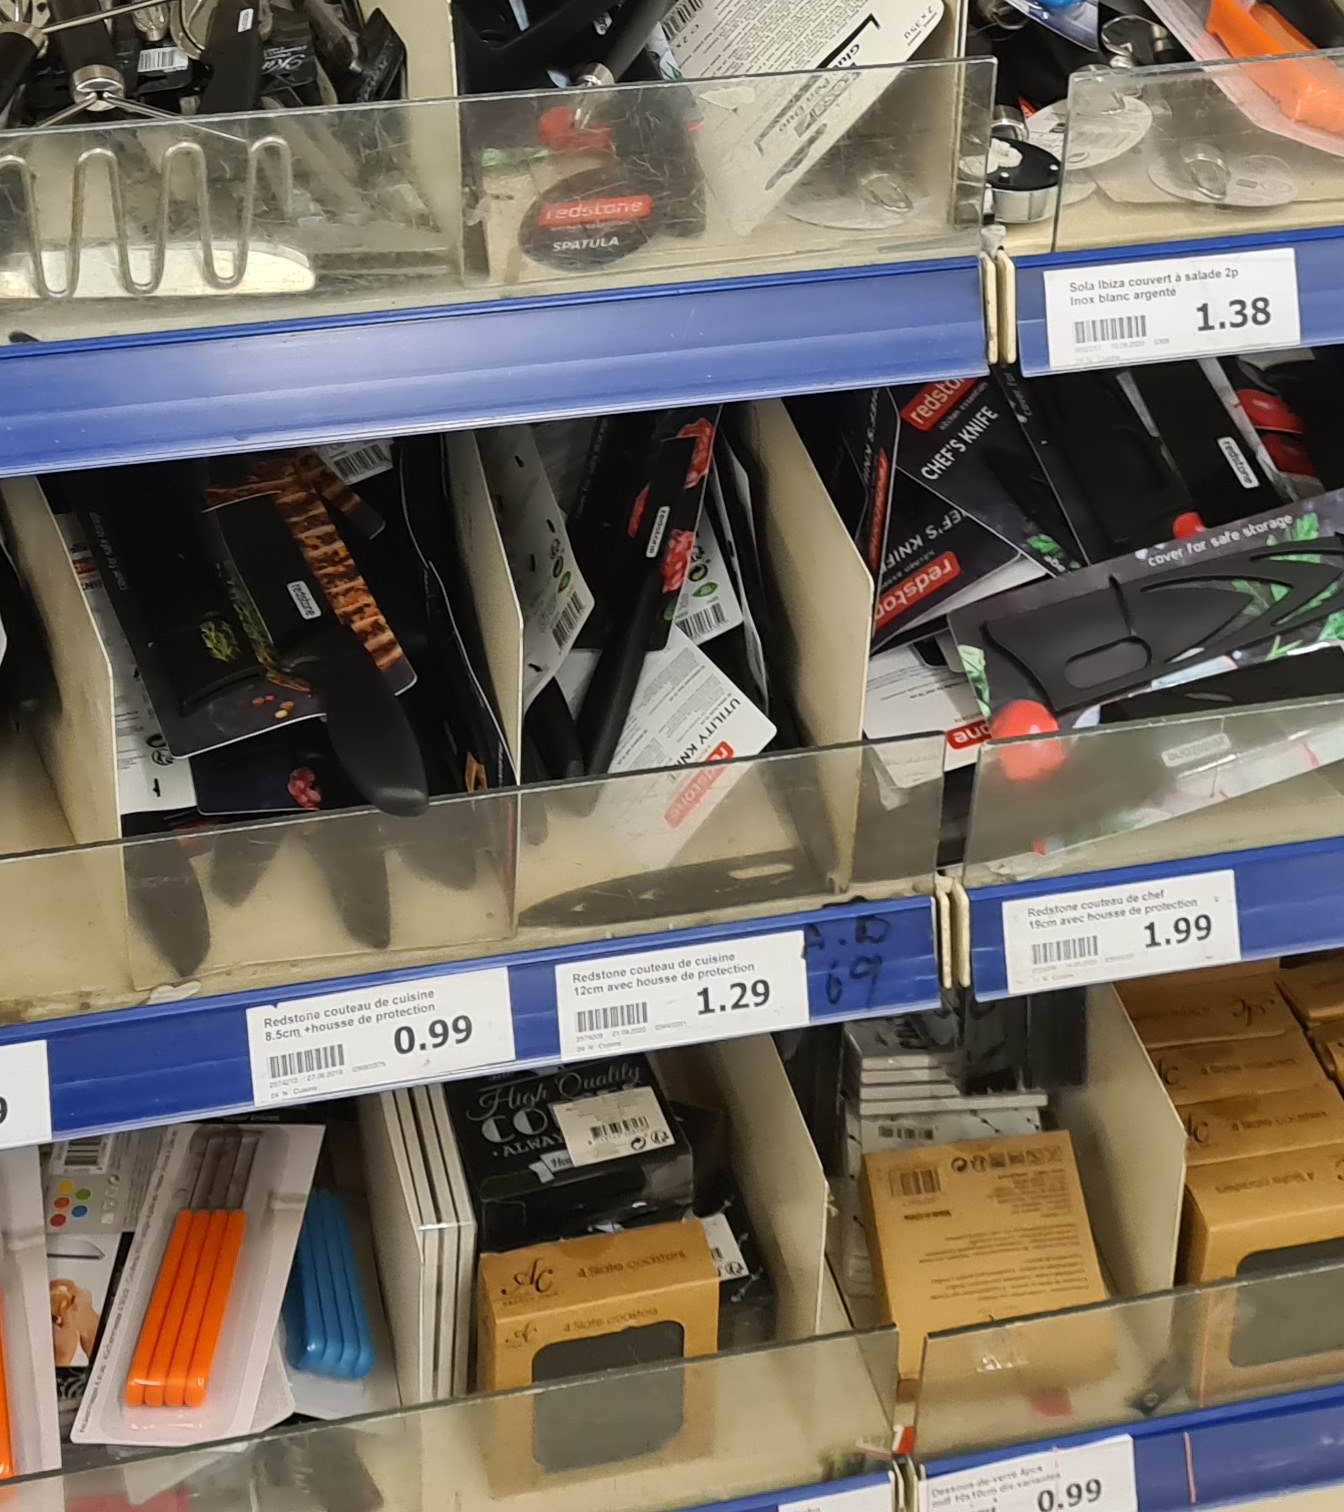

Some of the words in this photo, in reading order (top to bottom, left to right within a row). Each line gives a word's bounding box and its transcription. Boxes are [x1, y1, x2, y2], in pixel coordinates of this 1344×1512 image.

[545, 199, 644, 220] redstone
[552, 236, 620, 252] SPATULA
[1070, 280, 1095, 293] Sola
[1098, 278, 1125, 290] Ibiza
[1128, 273, 1172, 287] couvert
[1175, 271, 1182, 283] à
[1185, 268, 1222, 282] salade
[1225, 267, 1239, 280] 2p
[1098, 290, 1130, 304] blanc
[1133, 286, 1176, 302] argenté
[1196, 297, 1271, 332] 1.38
[921, 435, 966, 480] CHEF'S
[959, 404, 999, 444] KNIFE
[1222, 440, 1253, 486] redstone
[1148, 546, 1184, 567] cover
[1188, 539, 1206, 554] for
[1210, 529, 1240, 549] safe
[1243, 513, 1293, 538] storage
[699, 698, 741, 744] UTILITY
[1027, 903, 1078, 919] Redstone
[1081, 896, 1124, 911] couteau
[1126, 893, 1139, 904] de
[1142, 889, 1165, 902] chef
[1060, 913, 1084, 926] avec
[1088, 907, 1126, 922] housse
[1128, 904, 1142, 916] de
[1145, 897, 1198, 916] protection
[1143, 914, 1212, 949] 1.99
[572, 970, 627, 984] Redstone
[630, 962, 674, 976] couteau
[678, 959, 692, 969] de
[695, 952, 735, 966] cuisine
[574, 984, 604, 997] 12cm
[607, 981, 633, 993] avec
[636, 973, 677, 988] housse
[681, 970, 695, 981] de
[698, 962, 755, 982] protection
[264, 1013, 320, 1029] Redstone
[324, 1002, 371, 1018] couteau
[375, 997, 389, 1009] de
[392, 989, 435, 1005] cuisine
[697, 979, 770, 1016] 1.29
[265, 1026, 301, 1042] 8.5cm
[304, 1017, 354, 1034] +housse
[357, 1013, 372, 1025] de
[376, 1001, 436, 1024] protection
[393, 1014, 473, 1055] 0.99
[465, 1082, 548, 1121] High
[554, 1061, 642, 1099] Quality
[1037, 1477, 1103, 1512] 0.99
